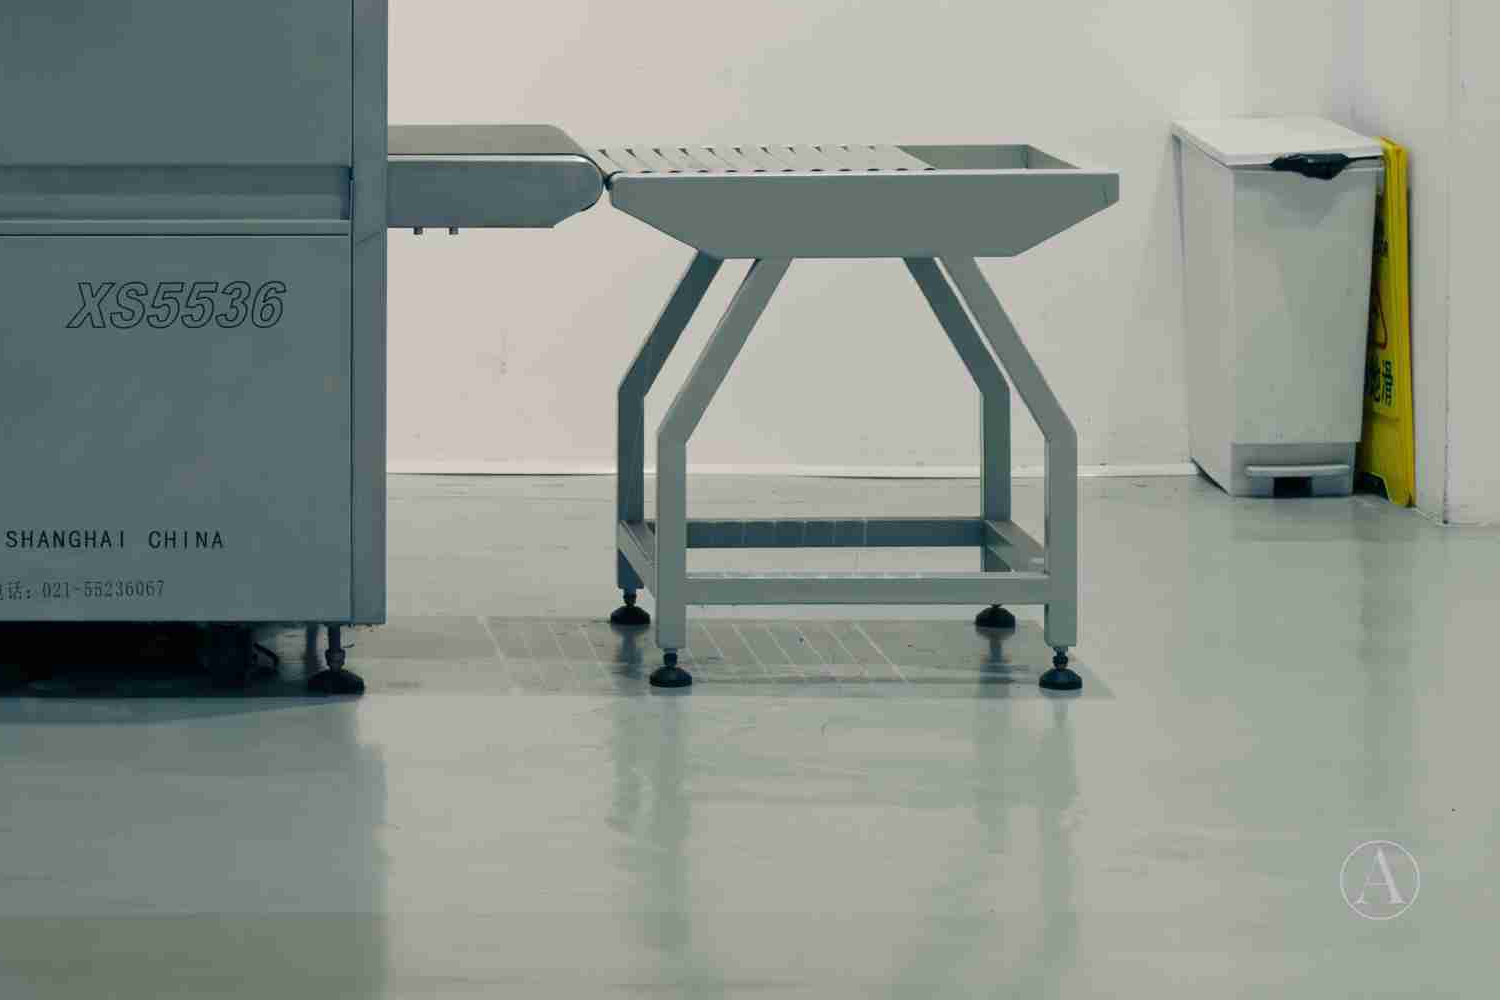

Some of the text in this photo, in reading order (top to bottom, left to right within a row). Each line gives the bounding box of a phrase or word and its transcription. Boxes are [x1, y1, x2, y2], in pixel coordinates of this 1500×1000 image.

[65, 280, 288, 330] XS5536
[4, 529, 125, 550] SHANGHAI
[147, 529, 225, 550] CHINA
